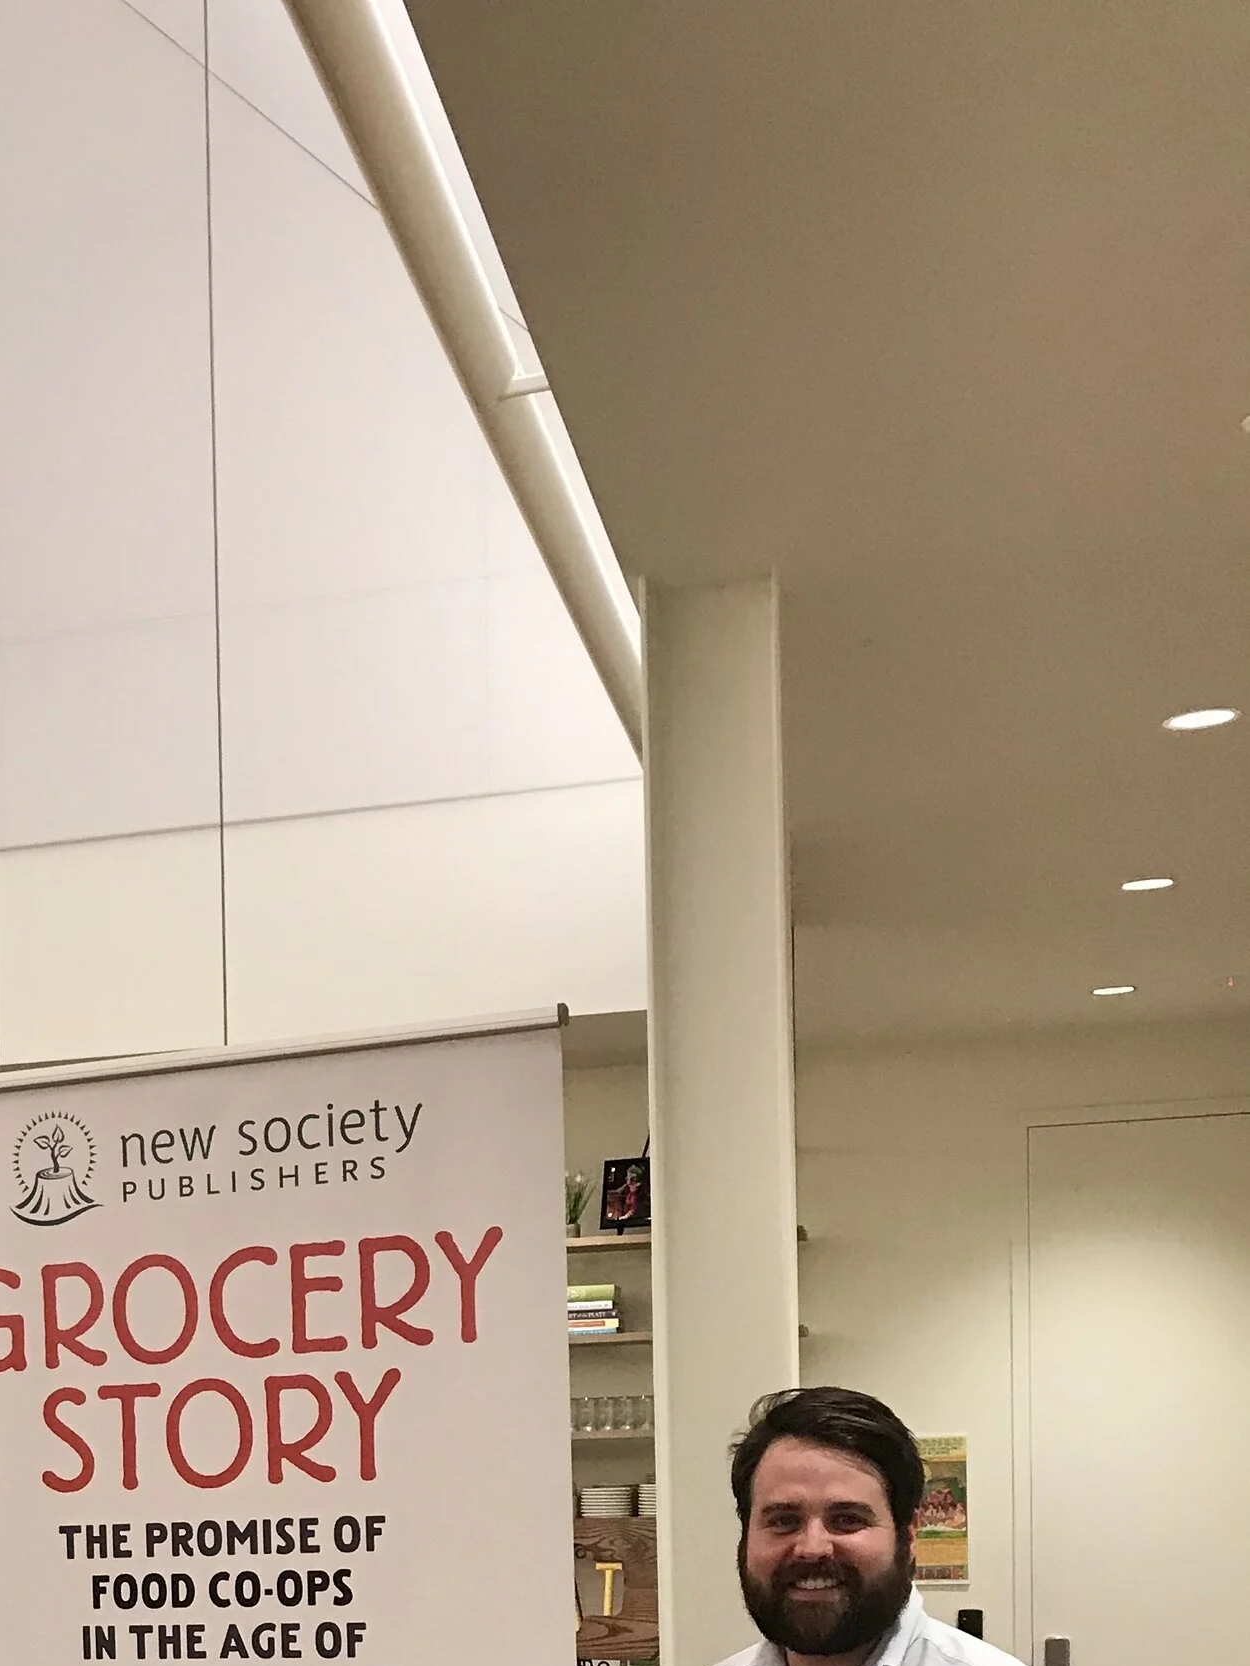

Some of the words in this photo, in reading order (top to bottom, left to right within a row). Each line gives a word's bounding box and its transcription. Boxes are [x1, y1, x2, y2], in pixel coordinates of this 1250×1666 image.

[121, 1125, 216, 1168] new
[239, 1100, 423, 1158] society
[122, 1156, 387, 1202] PUBLISHERS
[42, 1368, 401, 1492] STORY
[59, 1523, 132, 1559] THE
[146, 1517, 320, 1558] PROMISE
[334, 1515, 386, 1554] OF
[91, 1572, 196, 1610] FOOD
[208, 1569, 353, 1609] CO-OPS
[83, 1625, 116, 1661] IN
[129, 1624, 206, 1660] THE
[219, 1621, 301, 1659] AGE
[314, 1621, 367, 1658] OF
